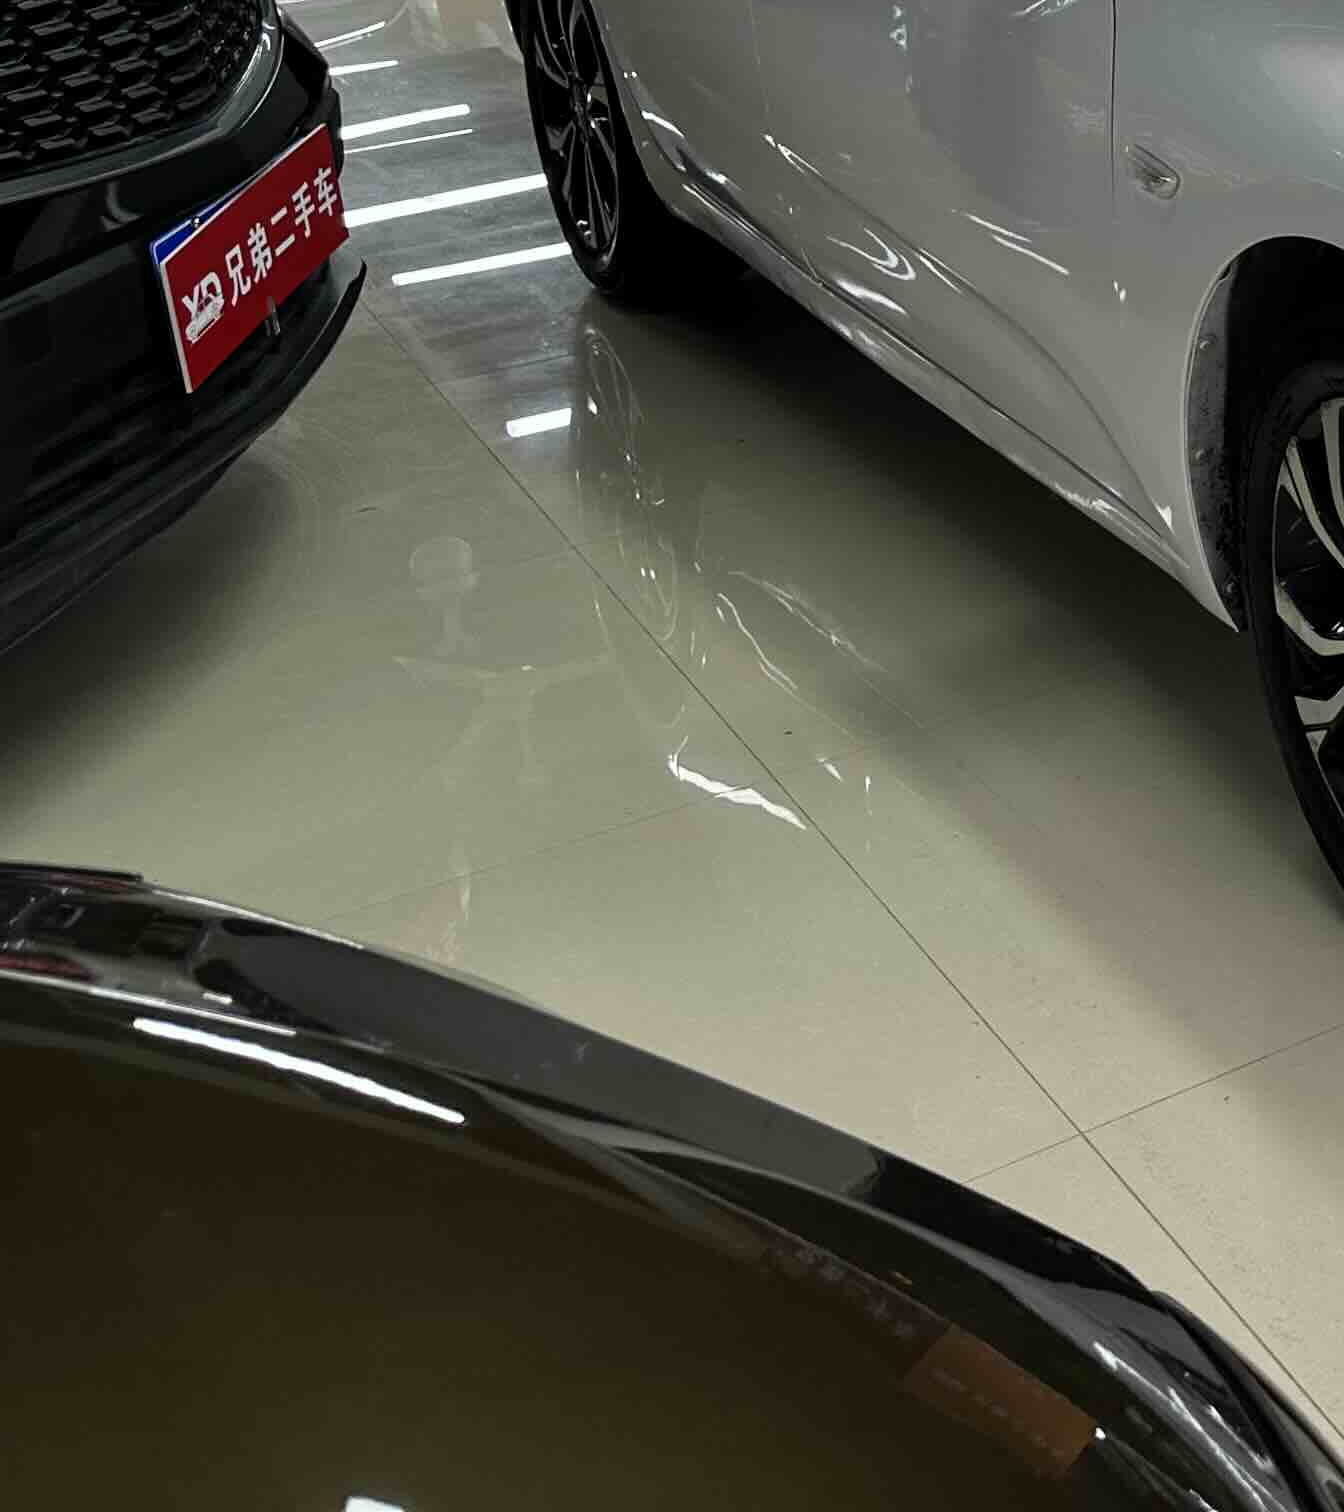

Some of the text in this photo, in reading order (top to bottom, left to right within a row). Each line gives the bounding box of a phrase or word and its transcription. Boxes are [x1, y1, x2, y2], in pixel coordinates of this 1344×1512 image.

[224, 167, 338, 307] 兄弟二手车
